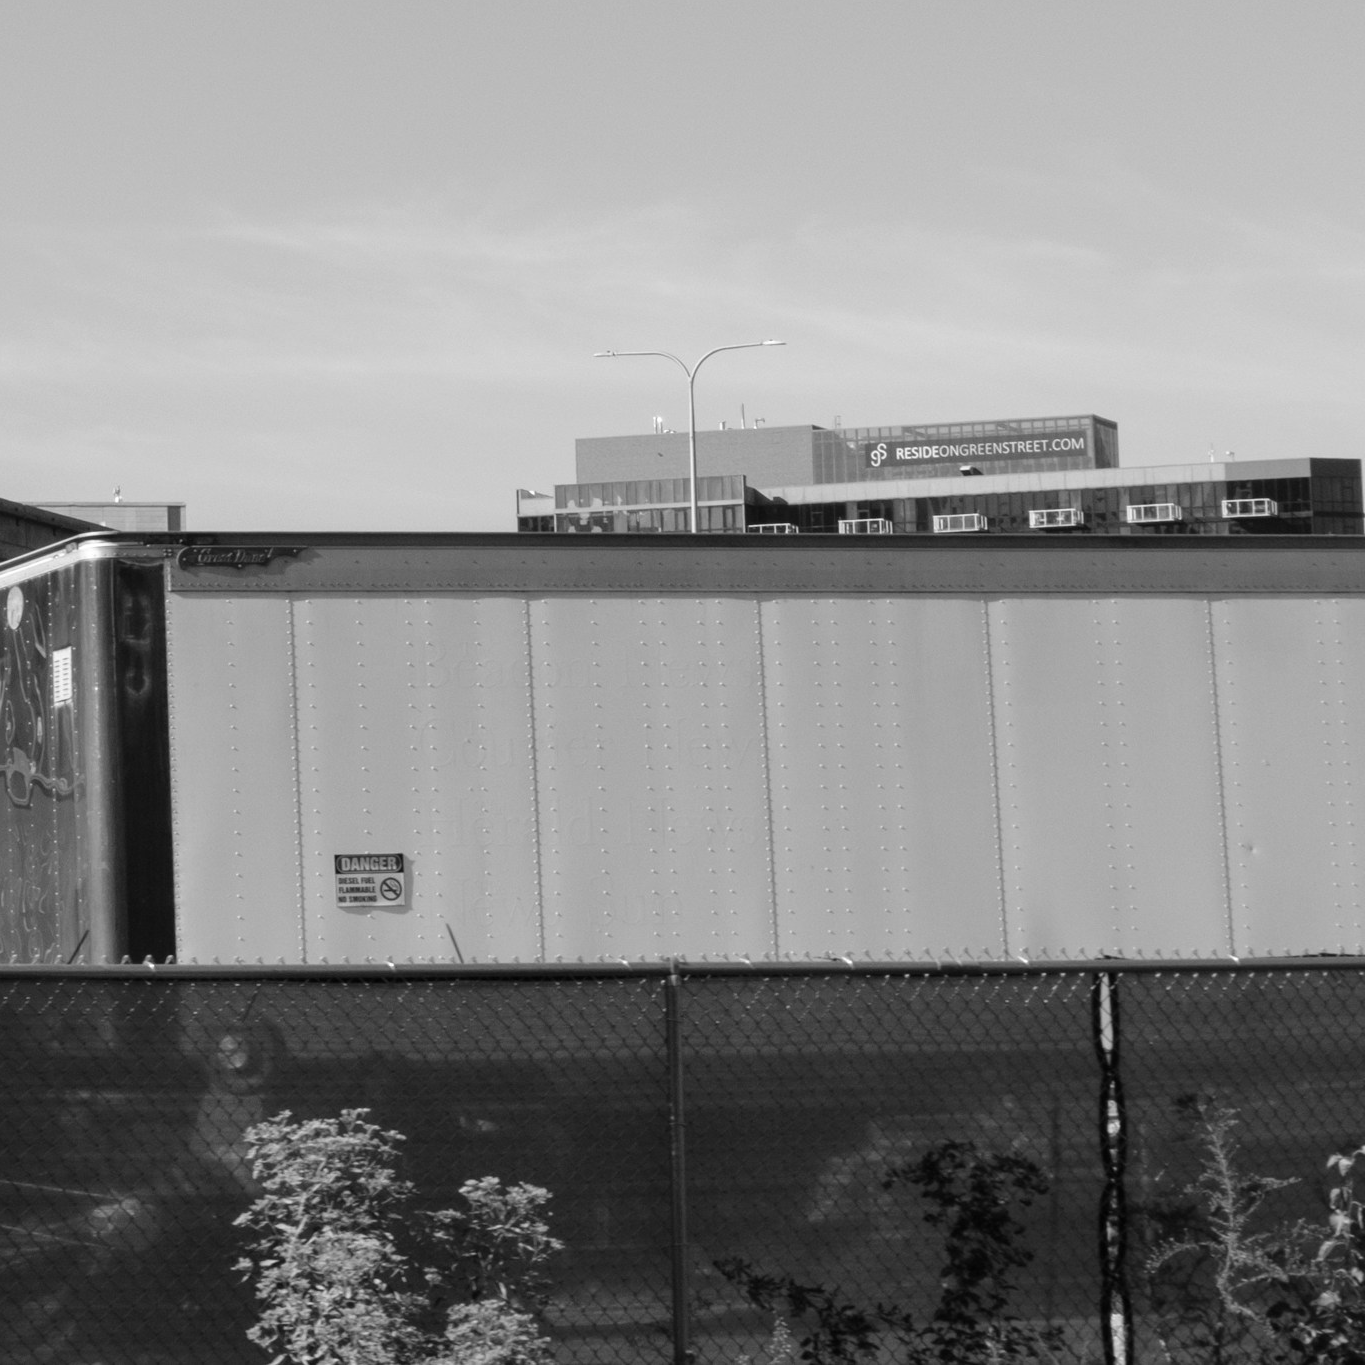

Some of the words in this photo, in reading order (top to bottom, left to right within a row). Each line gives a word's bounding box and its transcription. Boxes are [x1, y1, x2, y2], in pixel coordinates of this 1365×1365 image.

[895, 438, 1085, 460] RESIDEONGREENSTREET.COM
[341, 856, 398, 871] DANGER
[360, 876, 376, 885] FUEL
[338, 886, 376, 894] FLAMMABLE
[349, 895, 378, 903] SMOKING
